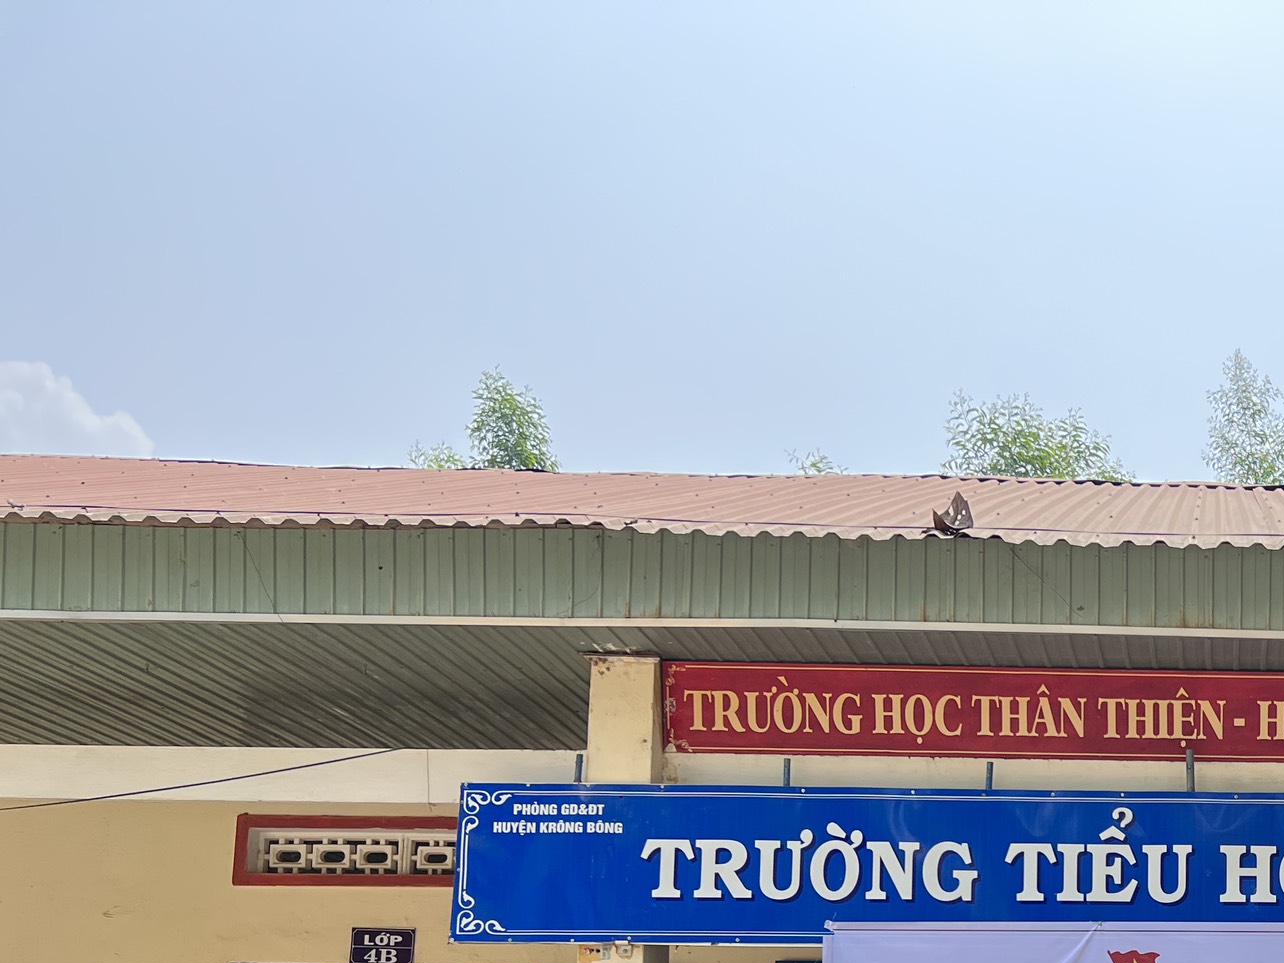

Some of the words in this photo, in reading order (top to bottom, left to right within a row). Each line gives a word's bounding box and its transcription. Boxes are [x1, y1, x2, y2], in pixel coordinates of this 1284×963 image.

[684, 676, 863, 735] TRƯỜNG
[872, 693, 963, 744] HỌC
[972, 685, 1087, 738] THÂN
[1098, 687, 1227, 748] THIỆN
[514, 802, 558, 816] PHÒNG
[561, 804, 605, 816] GD&ĐT
[493, 820, 537, 836] HUYỆN
[540, 820, 584, 834] KRÔNG
[587, 820, 624, 834] BÔNG
[641, 822, 978, 902] TRƯỜNG
[1005, 808, 1193, 904] TIỂU
[364, 932, 403, 946] LỚP
[364, 949, 397, 963] 4B
